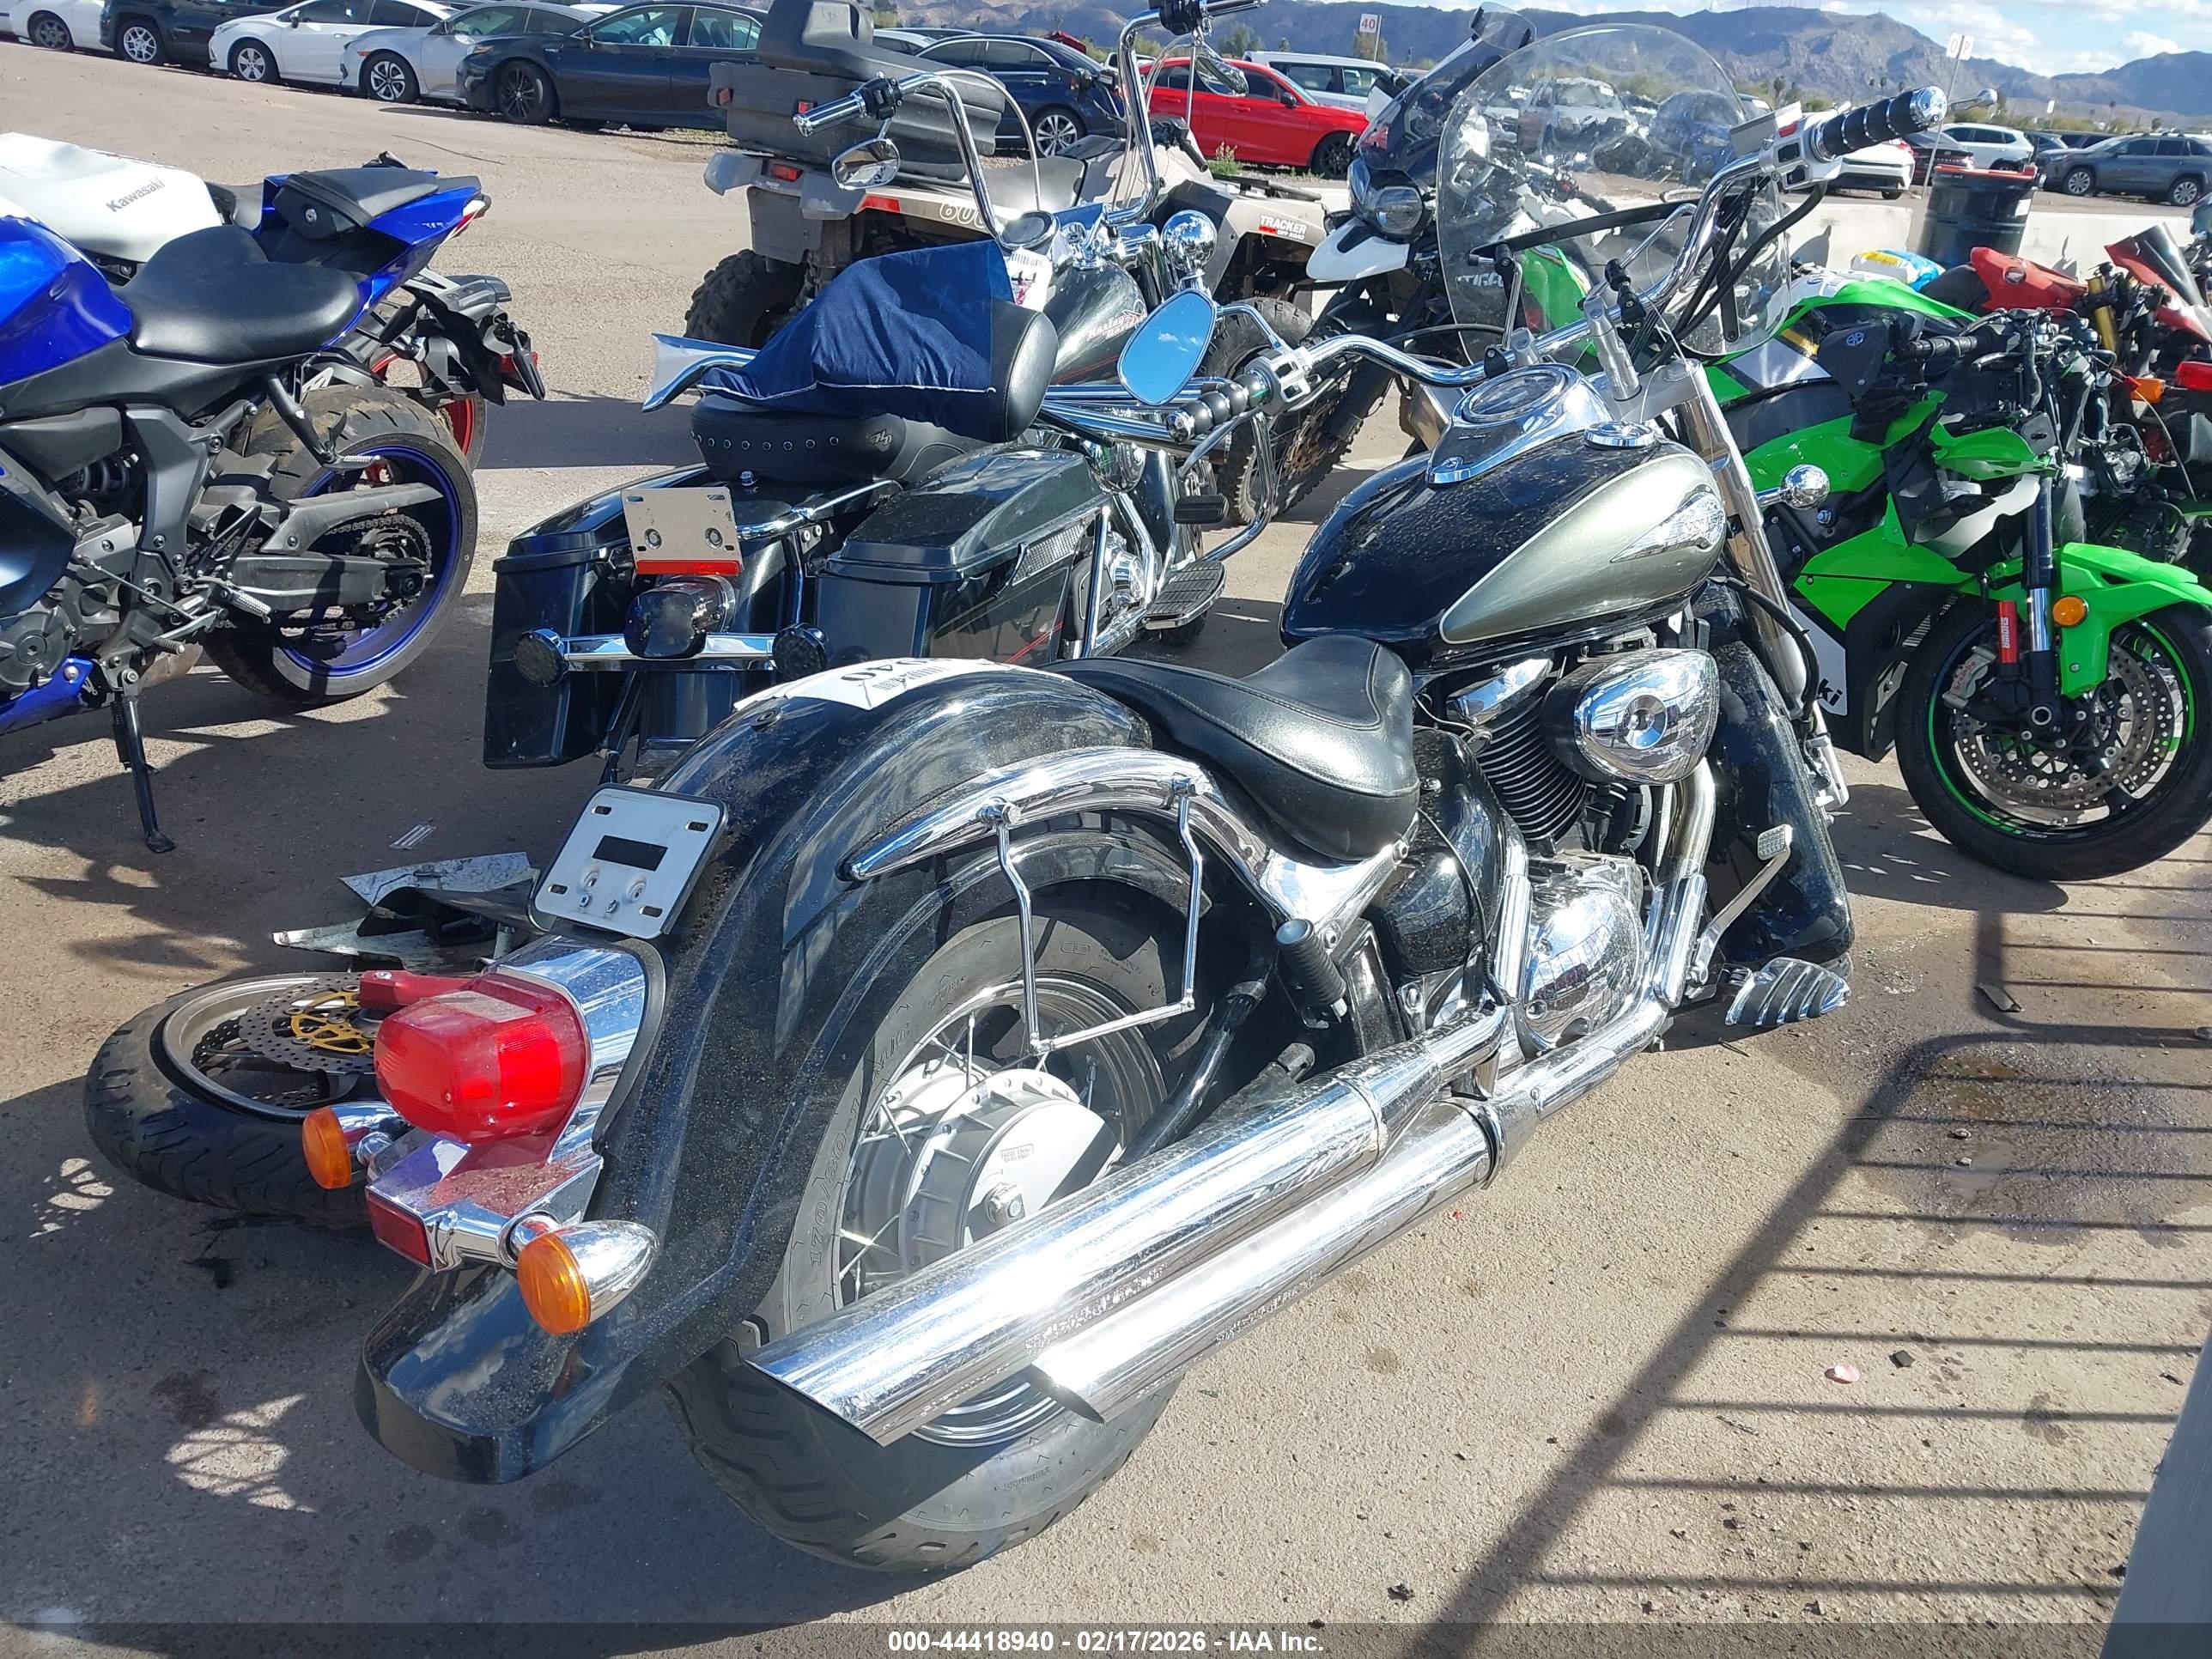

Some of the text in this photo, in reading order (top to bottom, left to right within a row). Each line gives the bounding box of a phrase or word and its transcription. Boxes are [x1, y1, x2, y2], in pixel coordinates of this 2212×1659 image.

[1361, 18, 1376, 28] 40
[106, 177, 166, 212] Kawasaki
[1260, 215, 1307, 234] TRACKER
[1289, 232, 1305, 240] ROAD
